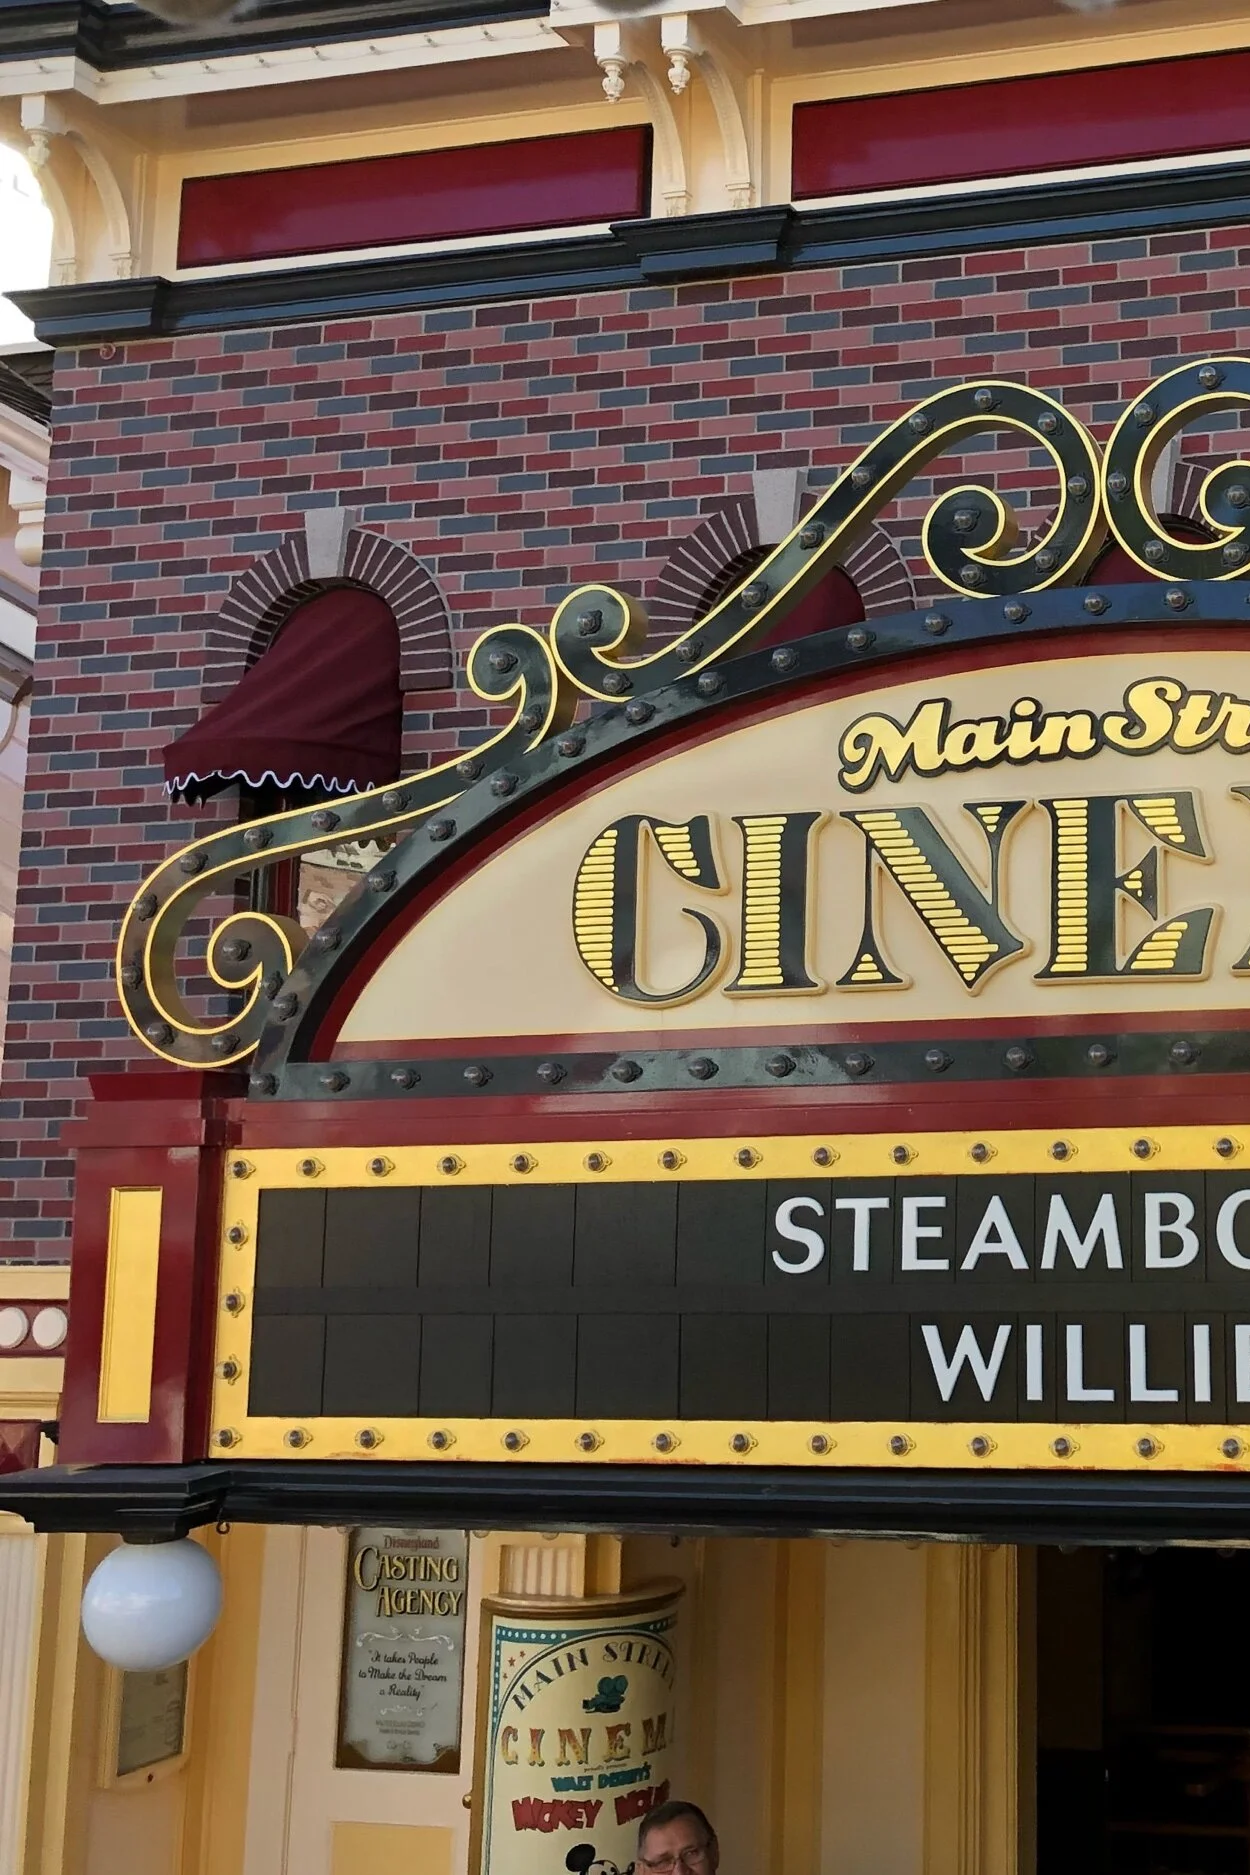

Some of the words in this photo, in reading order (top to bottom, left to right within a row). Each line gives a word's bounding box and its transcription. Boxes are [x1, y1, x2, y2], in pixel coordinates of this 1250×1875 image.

[838, 696, 1098, 794] Main
[354, 1545, 459, 1591] CASTING
[376, 1585, 463, 1617] AGENCY
[358, 1669, 367, 1679] to
[368, 1666, 396, 1680] Make
[398, 1667, 412, 1680] the
[414, 1668, 447, 1682] Dream
[384, 1651, 406, 1664] takes
[408, 1651, 440, 1669] People
[512, 1648, 589, 1711] MAIN
